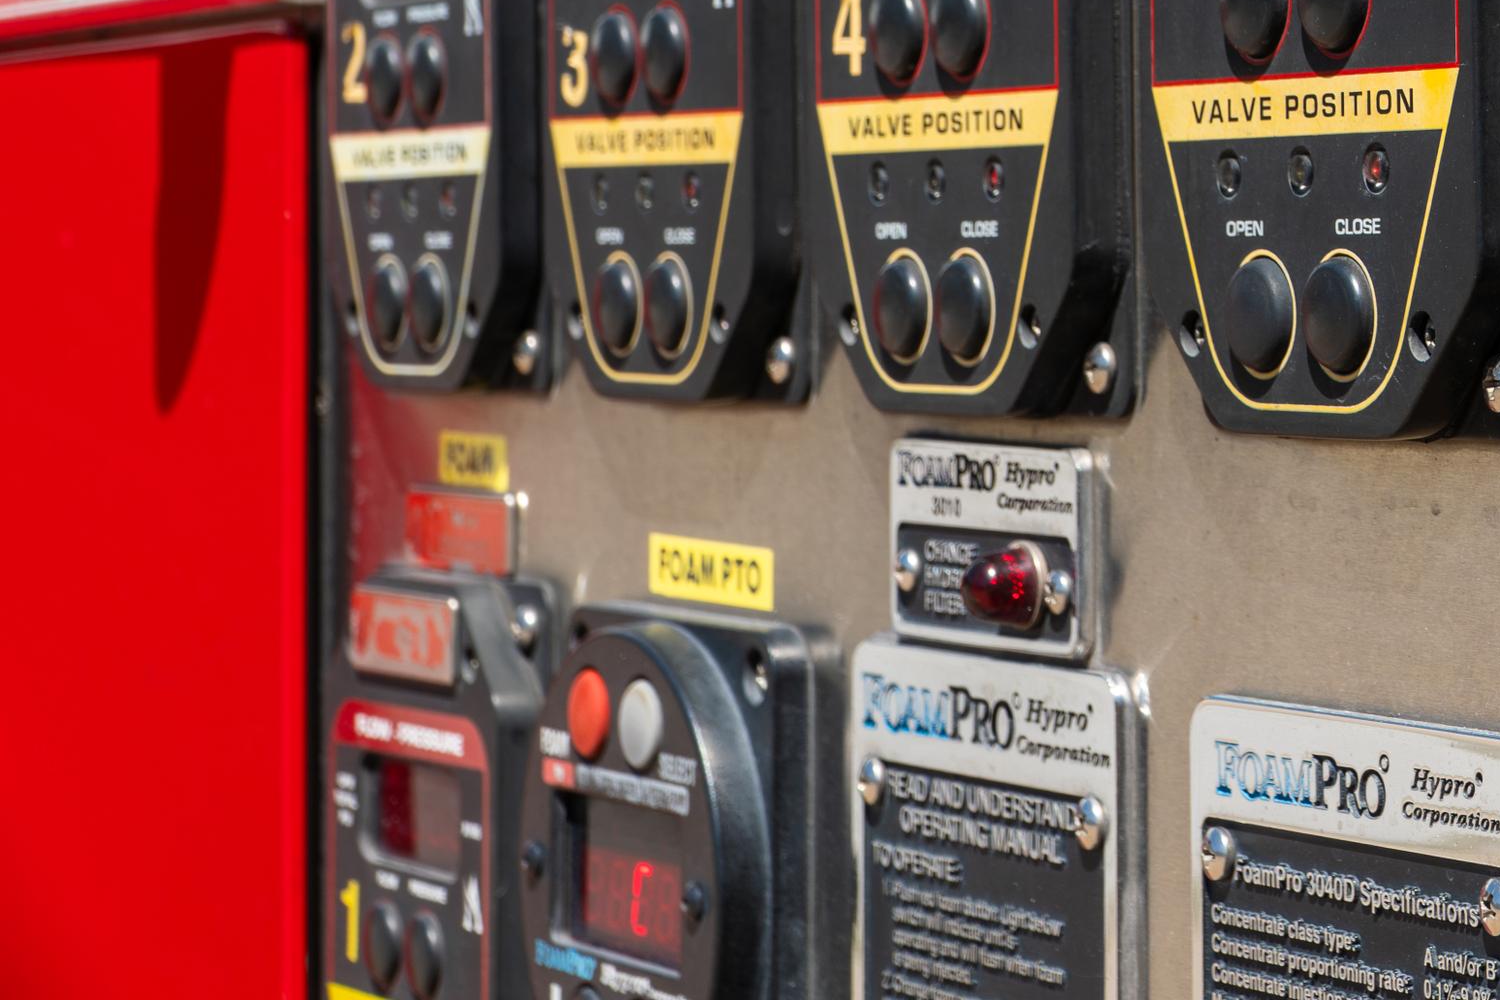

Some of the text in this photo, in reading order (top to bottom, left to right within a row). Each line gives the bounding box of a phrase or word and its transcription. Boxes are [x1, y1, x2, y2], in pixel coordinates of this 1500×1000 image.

[341, 20, 369, 104] 2
[561, 27, 589, 108] 3
[848, 109, 1025, 139] VALVE POSITION
[1191, 88, 1415, 125] VALVE POSITION
[575, 126, 717, 154] VALVE POSITION
[875, 221, 908, 240] OPEN
[960, 220, 1000, 239] CLOSE
[1226, 219, 1264, 238] OPEN
[1335, 217, 1382, 237] CLOSE
[446, 441, 495, 477] FOAM
[997, 493, 1074, 515] Corporation
[658, 551, 763, 596] FOAM PTO
[1025, 698, 1088, 733] Hypro
[1016, 735, 1111, 769] Corporation
[887, 768, 1080, 831] READ AND UNDERSTAND
[1411, 767, 1477, 801] Hypro
[899, 804, 1066, 865] OPERATING MANUAL
[872, 840, 894, 868] TO
[1234, 856, 1480, 928] FoamPro 3040D Specifications
[341, 879, 361, 964] 1
[1211, 902, 1358, 953] Concentrate class type:
[1211, 932, 1285, 967] Concentrate
[1288, 952, 1376, 993] proportioning
[1378, 971, 1410, 994] rate:
[1211, 962, 1285, 998] Concentrate
[1423, 947, 1497, 981] A and/or B
